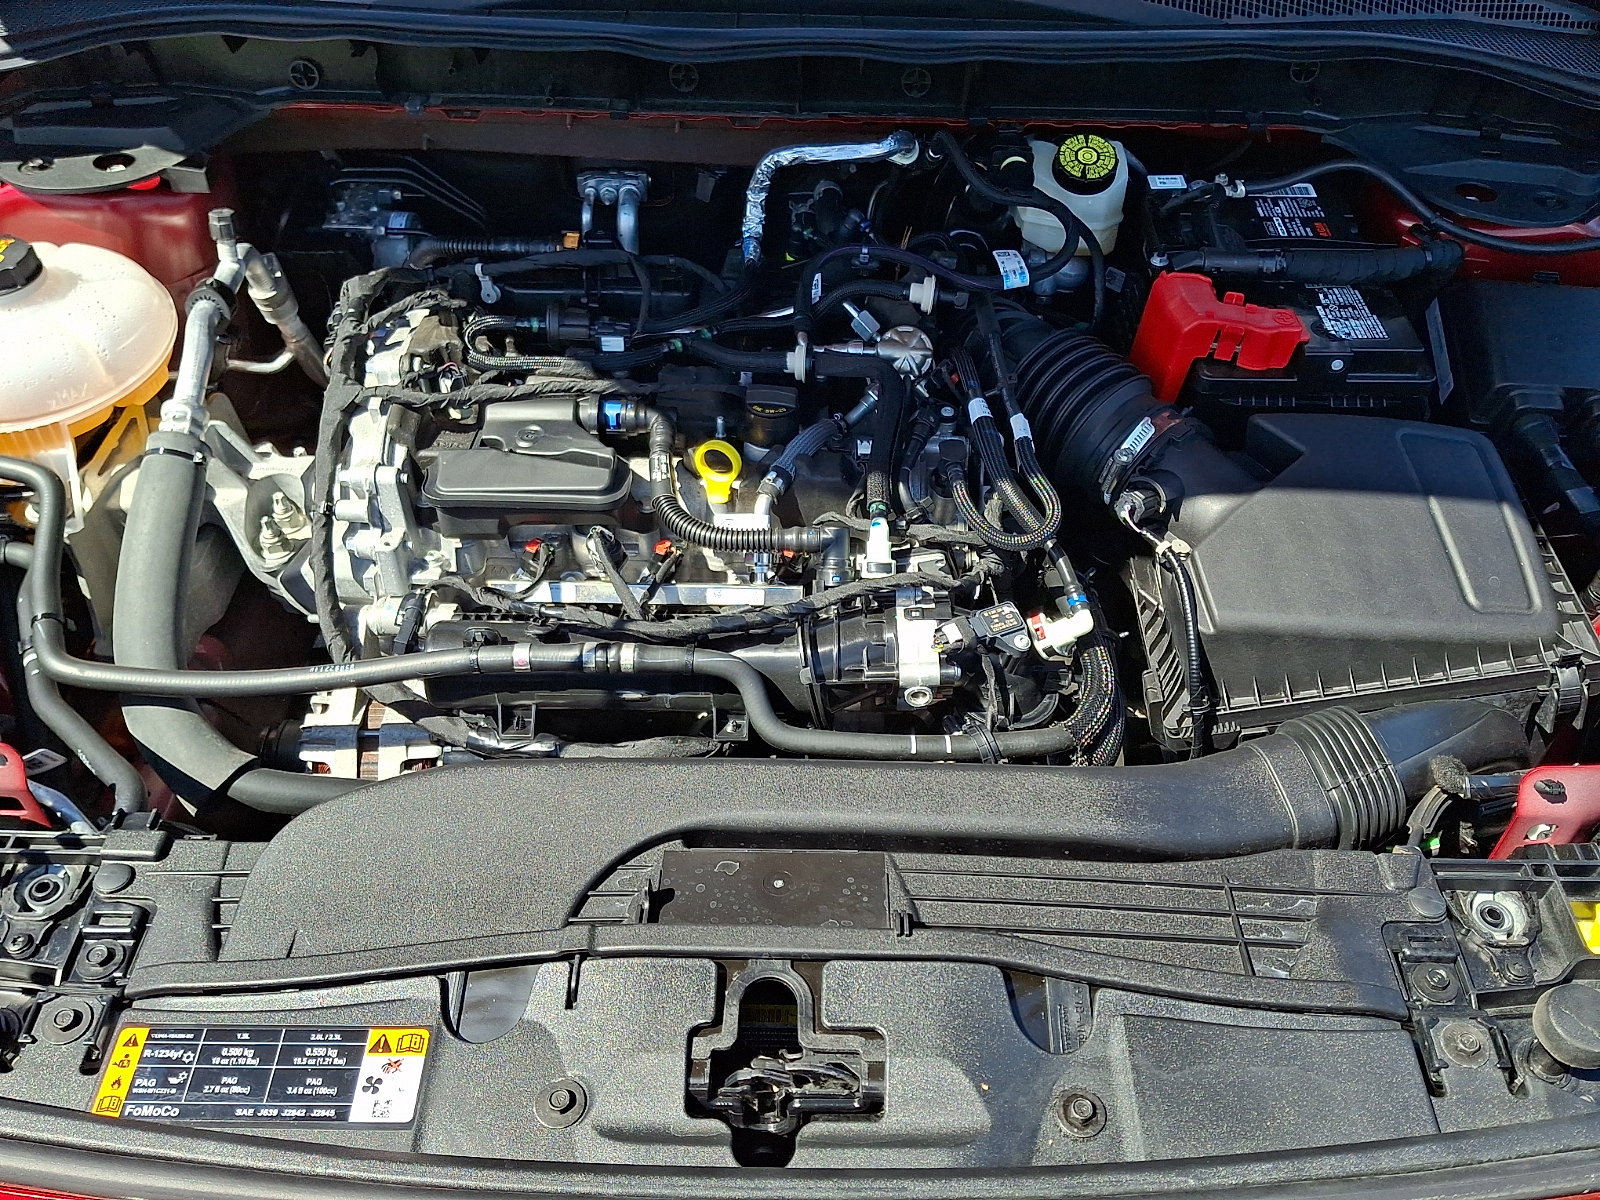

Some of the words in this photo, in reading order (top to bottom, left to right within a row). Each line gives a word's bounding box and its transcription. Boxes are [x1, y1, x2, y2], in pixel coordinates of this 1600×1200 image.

[143, 1049, 184, 1060] R-1234yf
[221, 1047, 243, 1056] 0.500
[243, 1047, 255, 1058] kg
[305, 1048, 327, 1056] 0.550
[327, 1048, 338, 1058] kg
[246, 1057, 260, 1066] lbs)
[316, 1057, 333, 1066] (1.21
[333, 1057, 346, 1066] lbs)
[134, 1078, 157, 1087] PAG
[203, 1085, 215, 1093] 2.7
[313, 1087, 338, 1096] (100cc)
[124, 1105, 180, 1117] FoMoCo
[235, 1109, 255, 1117] SAE
[257, 1109, 278, 1117] J639
[281, 1109, 307, 1117] J2842
[310, 1109, 336, 1117] J2845
